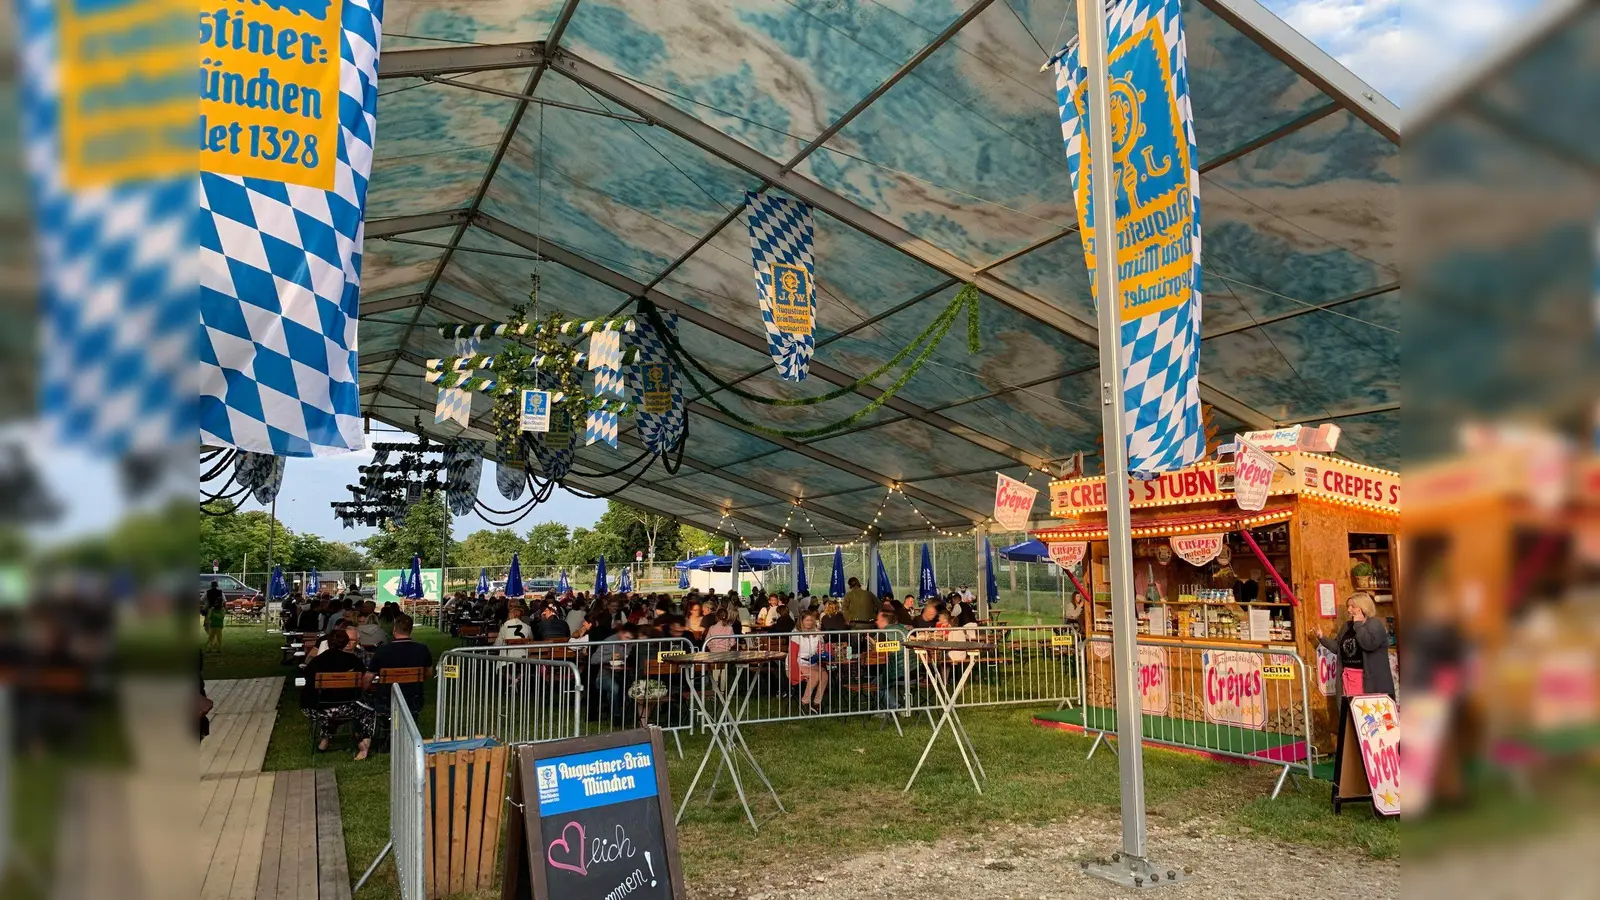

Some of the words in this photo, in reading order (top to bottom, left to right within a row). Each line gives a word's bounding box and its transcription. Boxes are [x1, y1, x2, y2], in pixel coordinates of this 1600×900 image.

[249, 124, 319, 169] 1328
[1235, 452, 1272, 488] Crêpes
[1323, 470, 1383, 502] CREPES
[1389, 484, 1400, 505] S
[997, 486, 1033, 513] Crêpes
[507, 624, 526, 638] 3
[1208, 667, 1260, 707] Crêpes
[582, 774, 636, 797] München
[587, 825, 636, 868] lich
